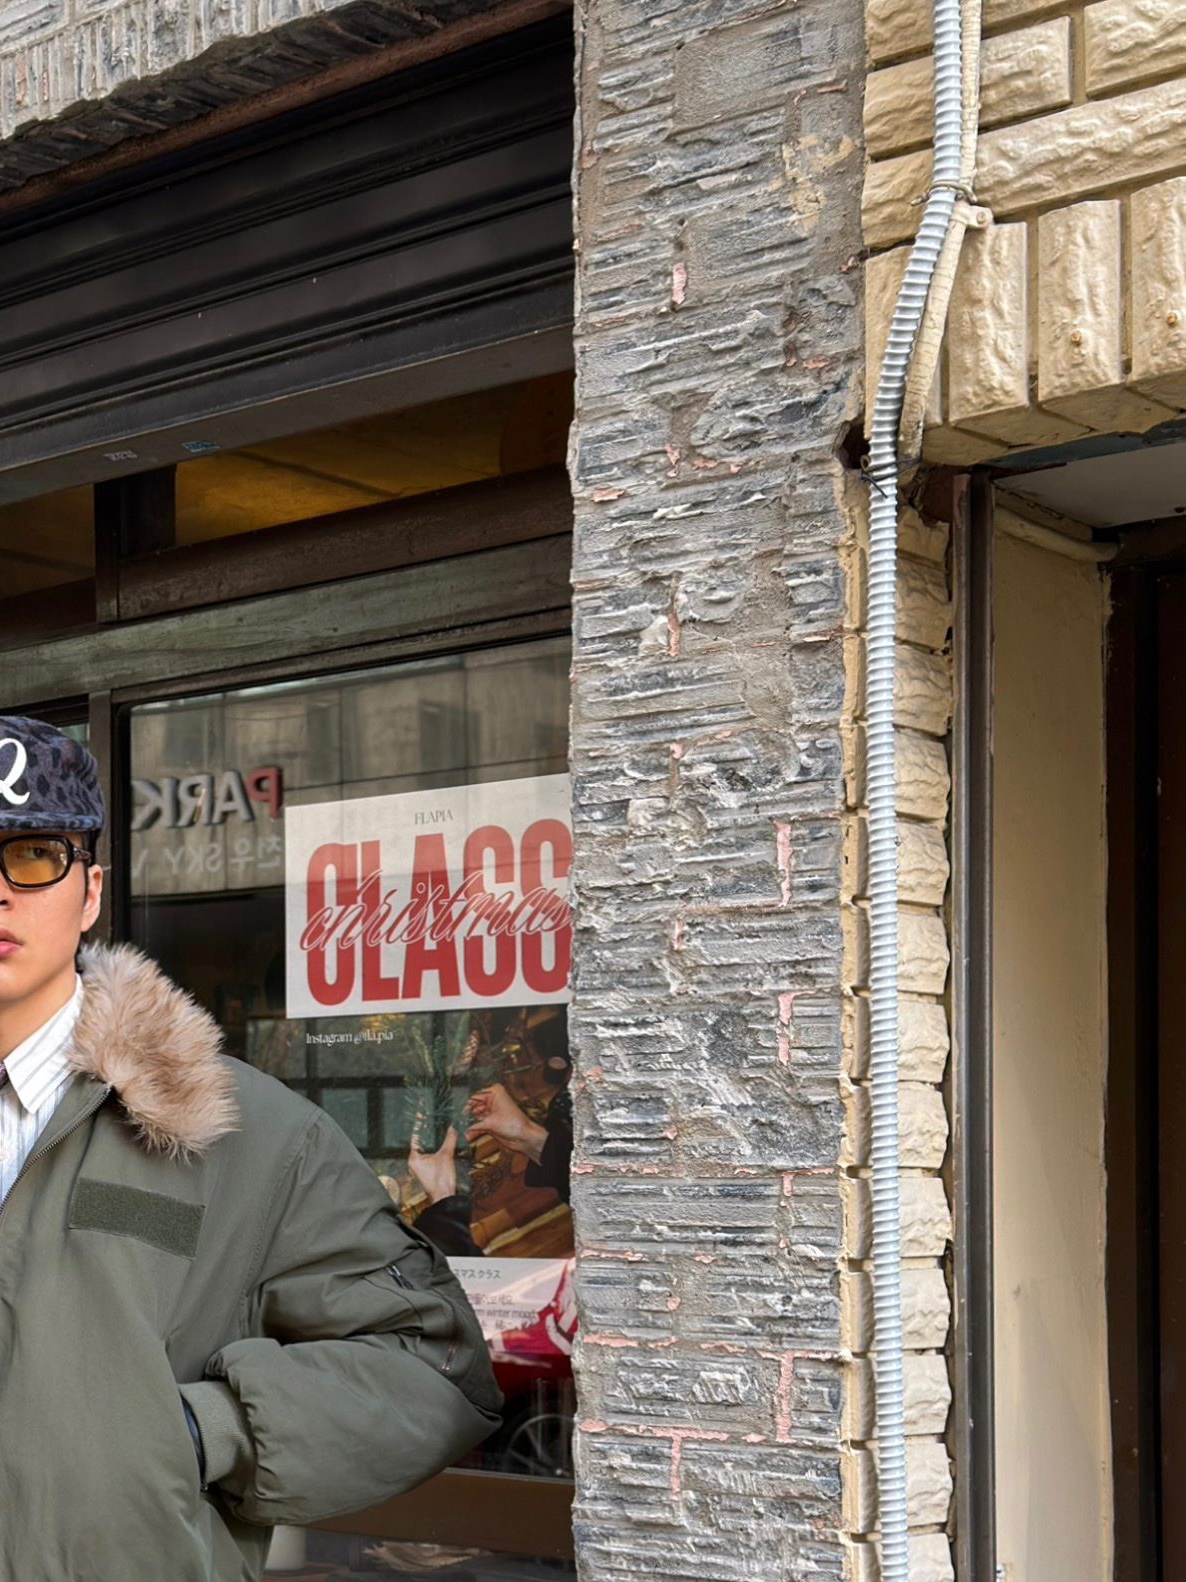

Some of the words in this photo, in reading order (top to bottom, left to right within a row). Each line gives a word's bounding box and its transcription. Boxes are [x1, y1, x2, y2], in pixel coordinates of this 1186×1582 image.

[300, 869, 574, 951] christmas
[307, 818, 572, 1006] CLASS
[306, 1032, 353, 1047] Instagram
